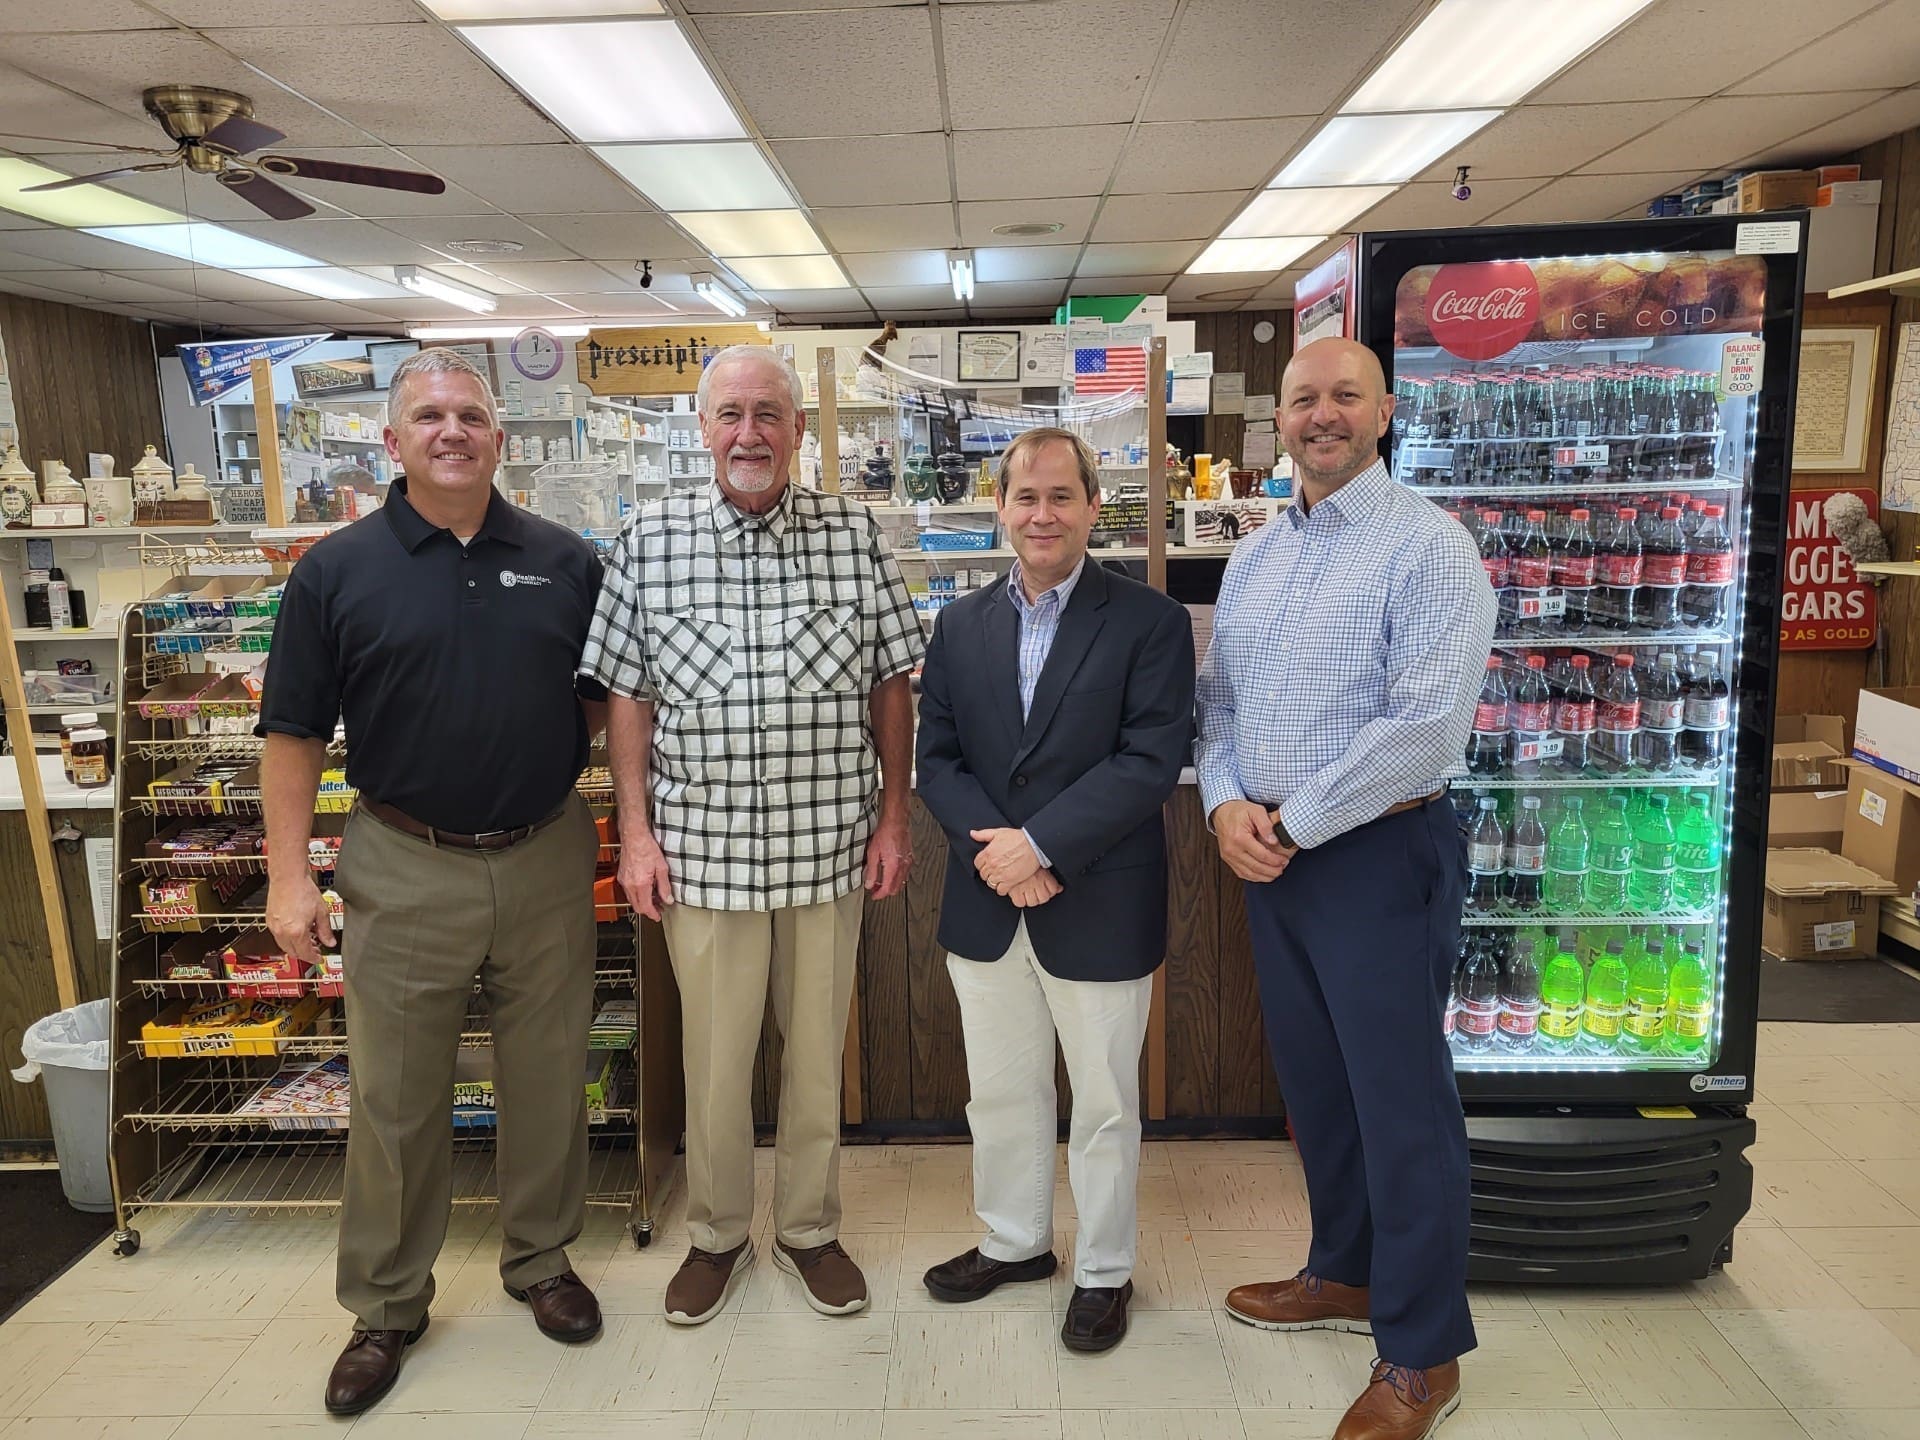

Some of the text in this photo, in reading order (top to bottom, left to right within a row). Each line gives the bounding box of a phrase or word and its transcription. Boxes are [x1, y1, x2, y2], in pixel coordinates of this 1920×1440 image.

[1432, 286, 1533, 323] Coca-Cola
[1560, 307, 1717, 331] ICE COLD
[1726, 344, 1761, 353] BALANCE
[214, 357, 243, 373] FOOTBALL
[271, 341, 305, 356] CHAMPIONS
[1735, 357, 1750, 366] EAT
[1730, 365, 1754, 374] DRINK
[1739, 373, 1751, 381] DO
[231, 513, 249, 522] DOG
[516, 573, 537, 582] Health
[1794, 629, 1817, 641] AS
[1823, 628, 1870, 640] GOLD
[229, 971, 278, 982] Skittles
[1710, 1077, 1745, 1086] Imbera
[455, 1085, 483, 1096] OUR
